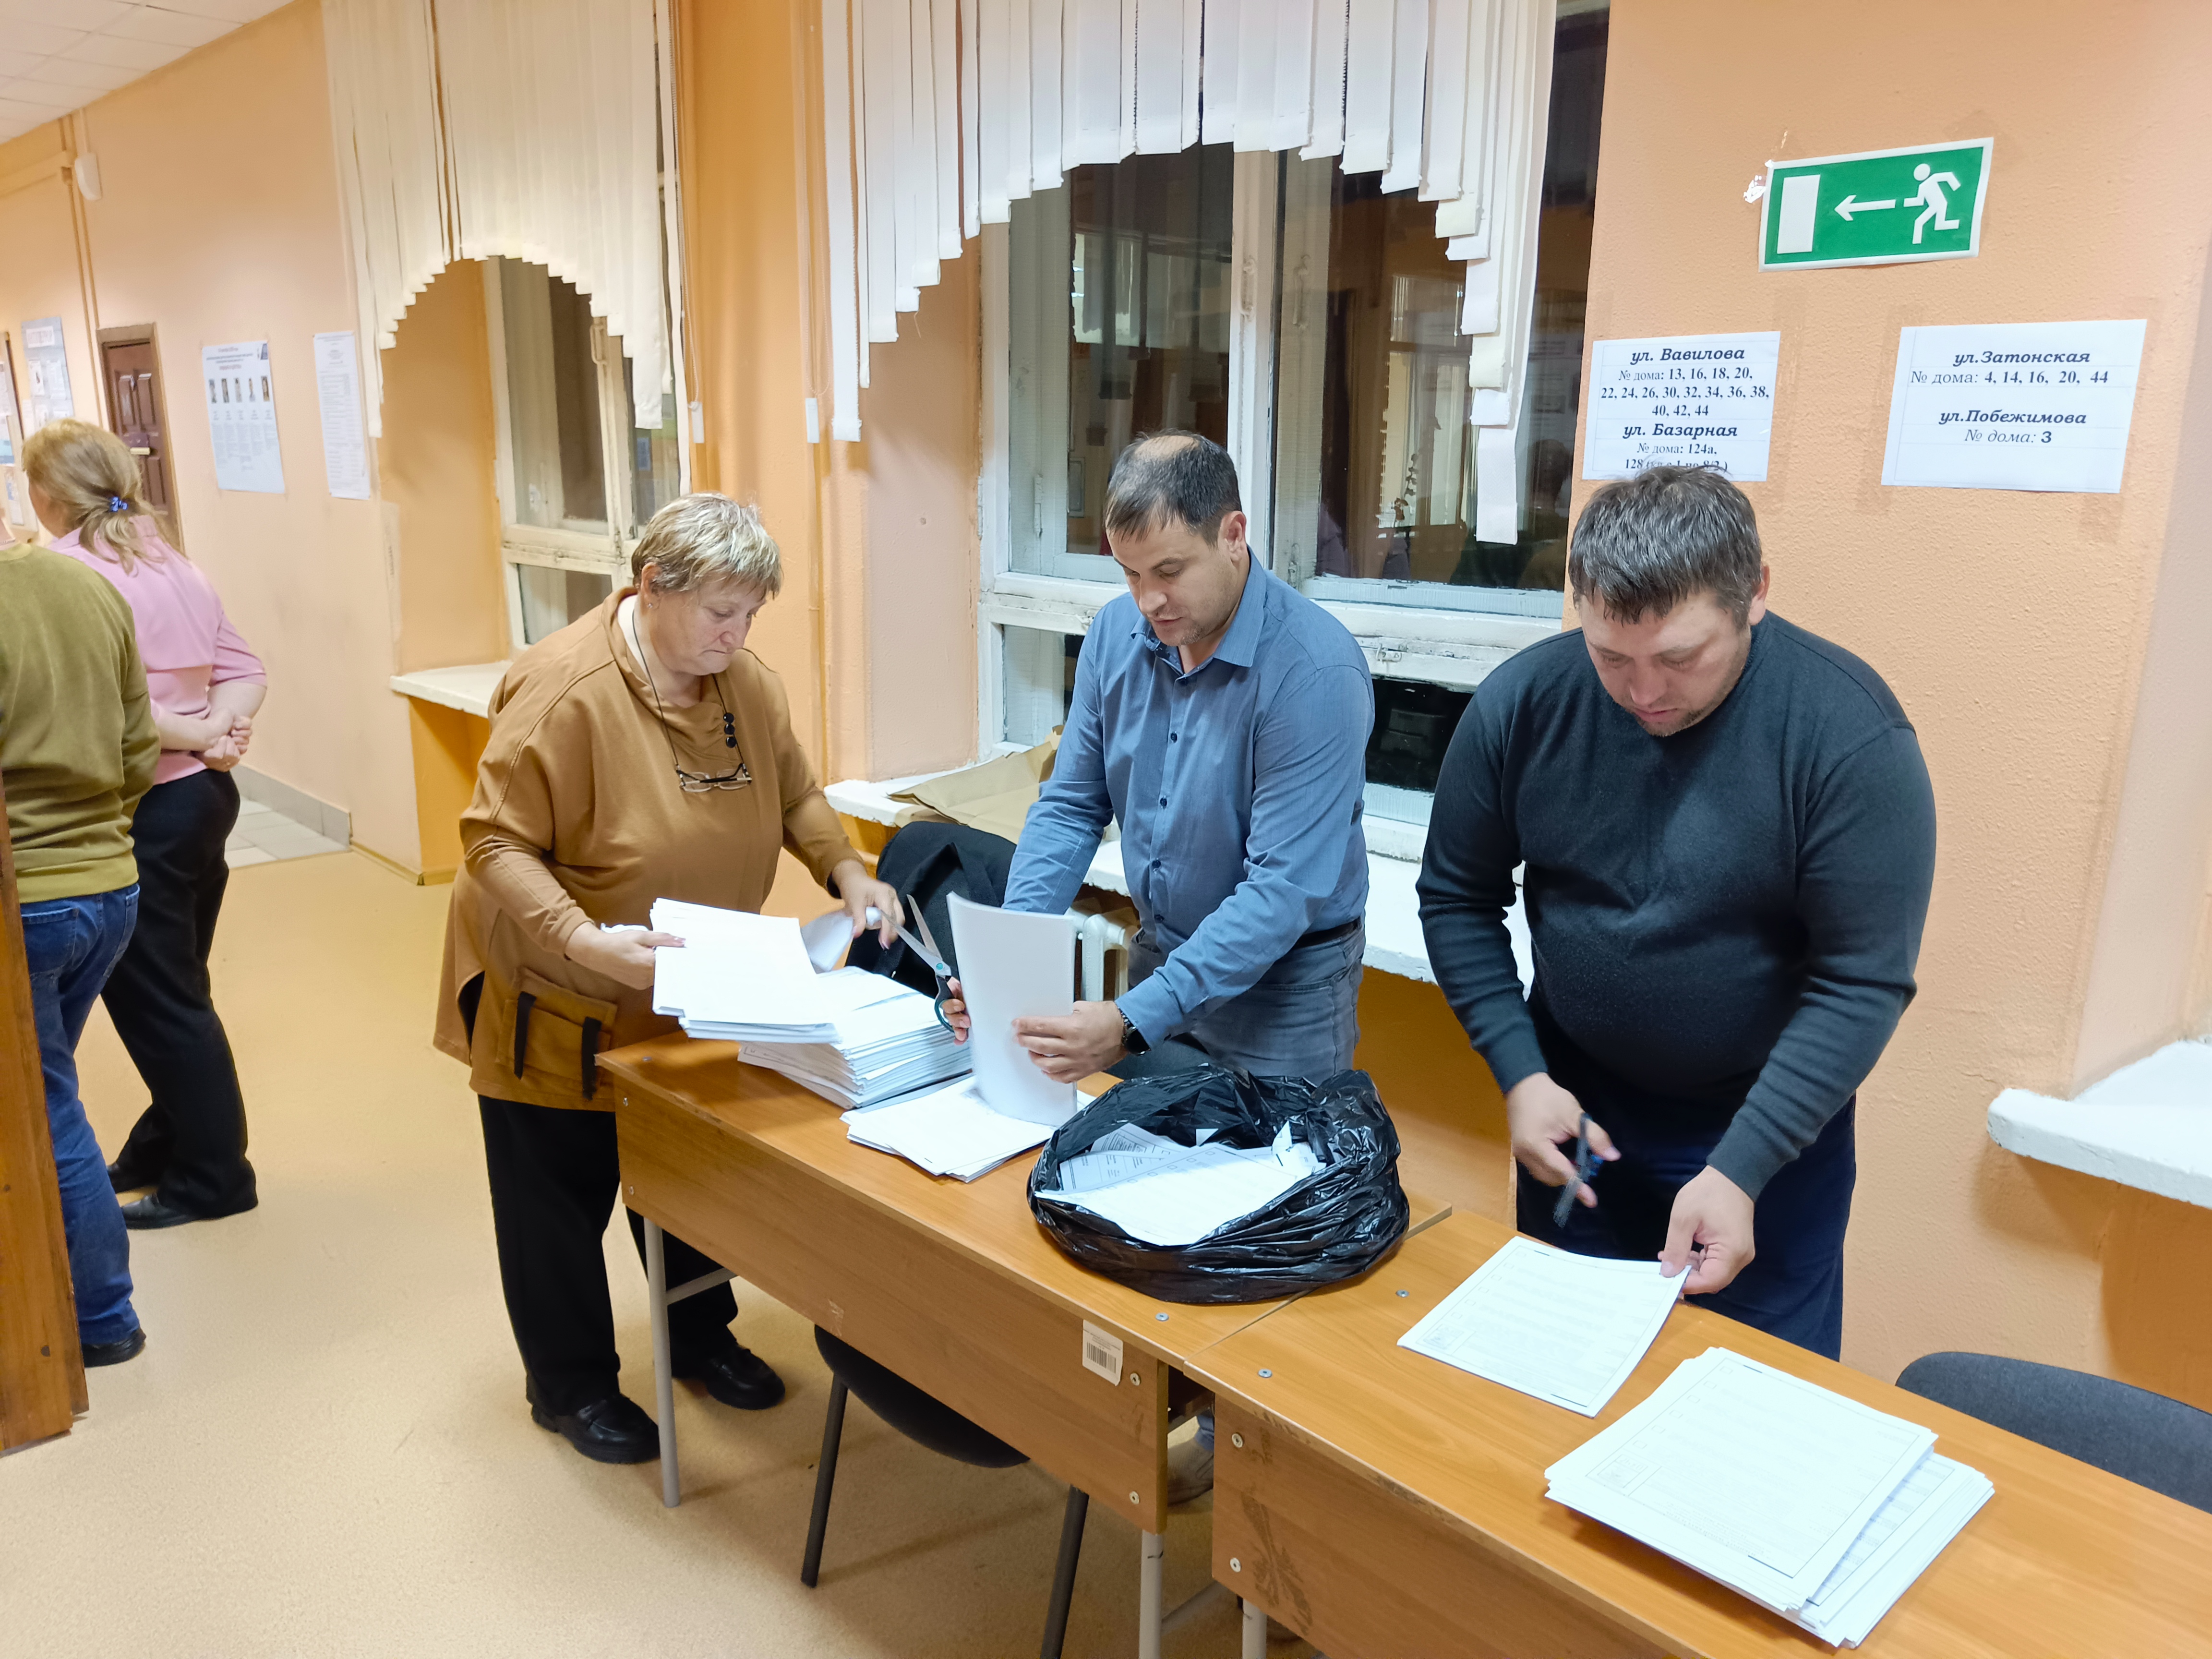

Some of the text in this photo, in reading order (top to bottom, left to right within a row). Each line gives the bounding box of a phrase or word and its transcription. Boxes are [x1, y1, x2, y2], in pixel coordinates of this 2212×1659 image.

[1630, 348, 1745, 365] ул. Вавилова
[1952, 350, 2091, 367] ул.Затонская
[1618, 367, 1753, 381] № дома: 13, 16, 18, 20,
[1911, 371, 2109, 385] № дома: 4, 14, 16, 20, 44
[1600, 385, 1770, 399] 22, 24, 26, 30, 32, 34, 36, 38,
[1652, 404, 1709, 417] 40, 42, 44
[1938, 409, 2087, 425] ул.Побежимова
[1622, 423, 1738, 441] ул. Базарная
[1964, 429, 2053, 444] № дома: 3
[1636, 443, 1718, 456] № дома: 124а,
[1625, 458, 1644, 469] 128
